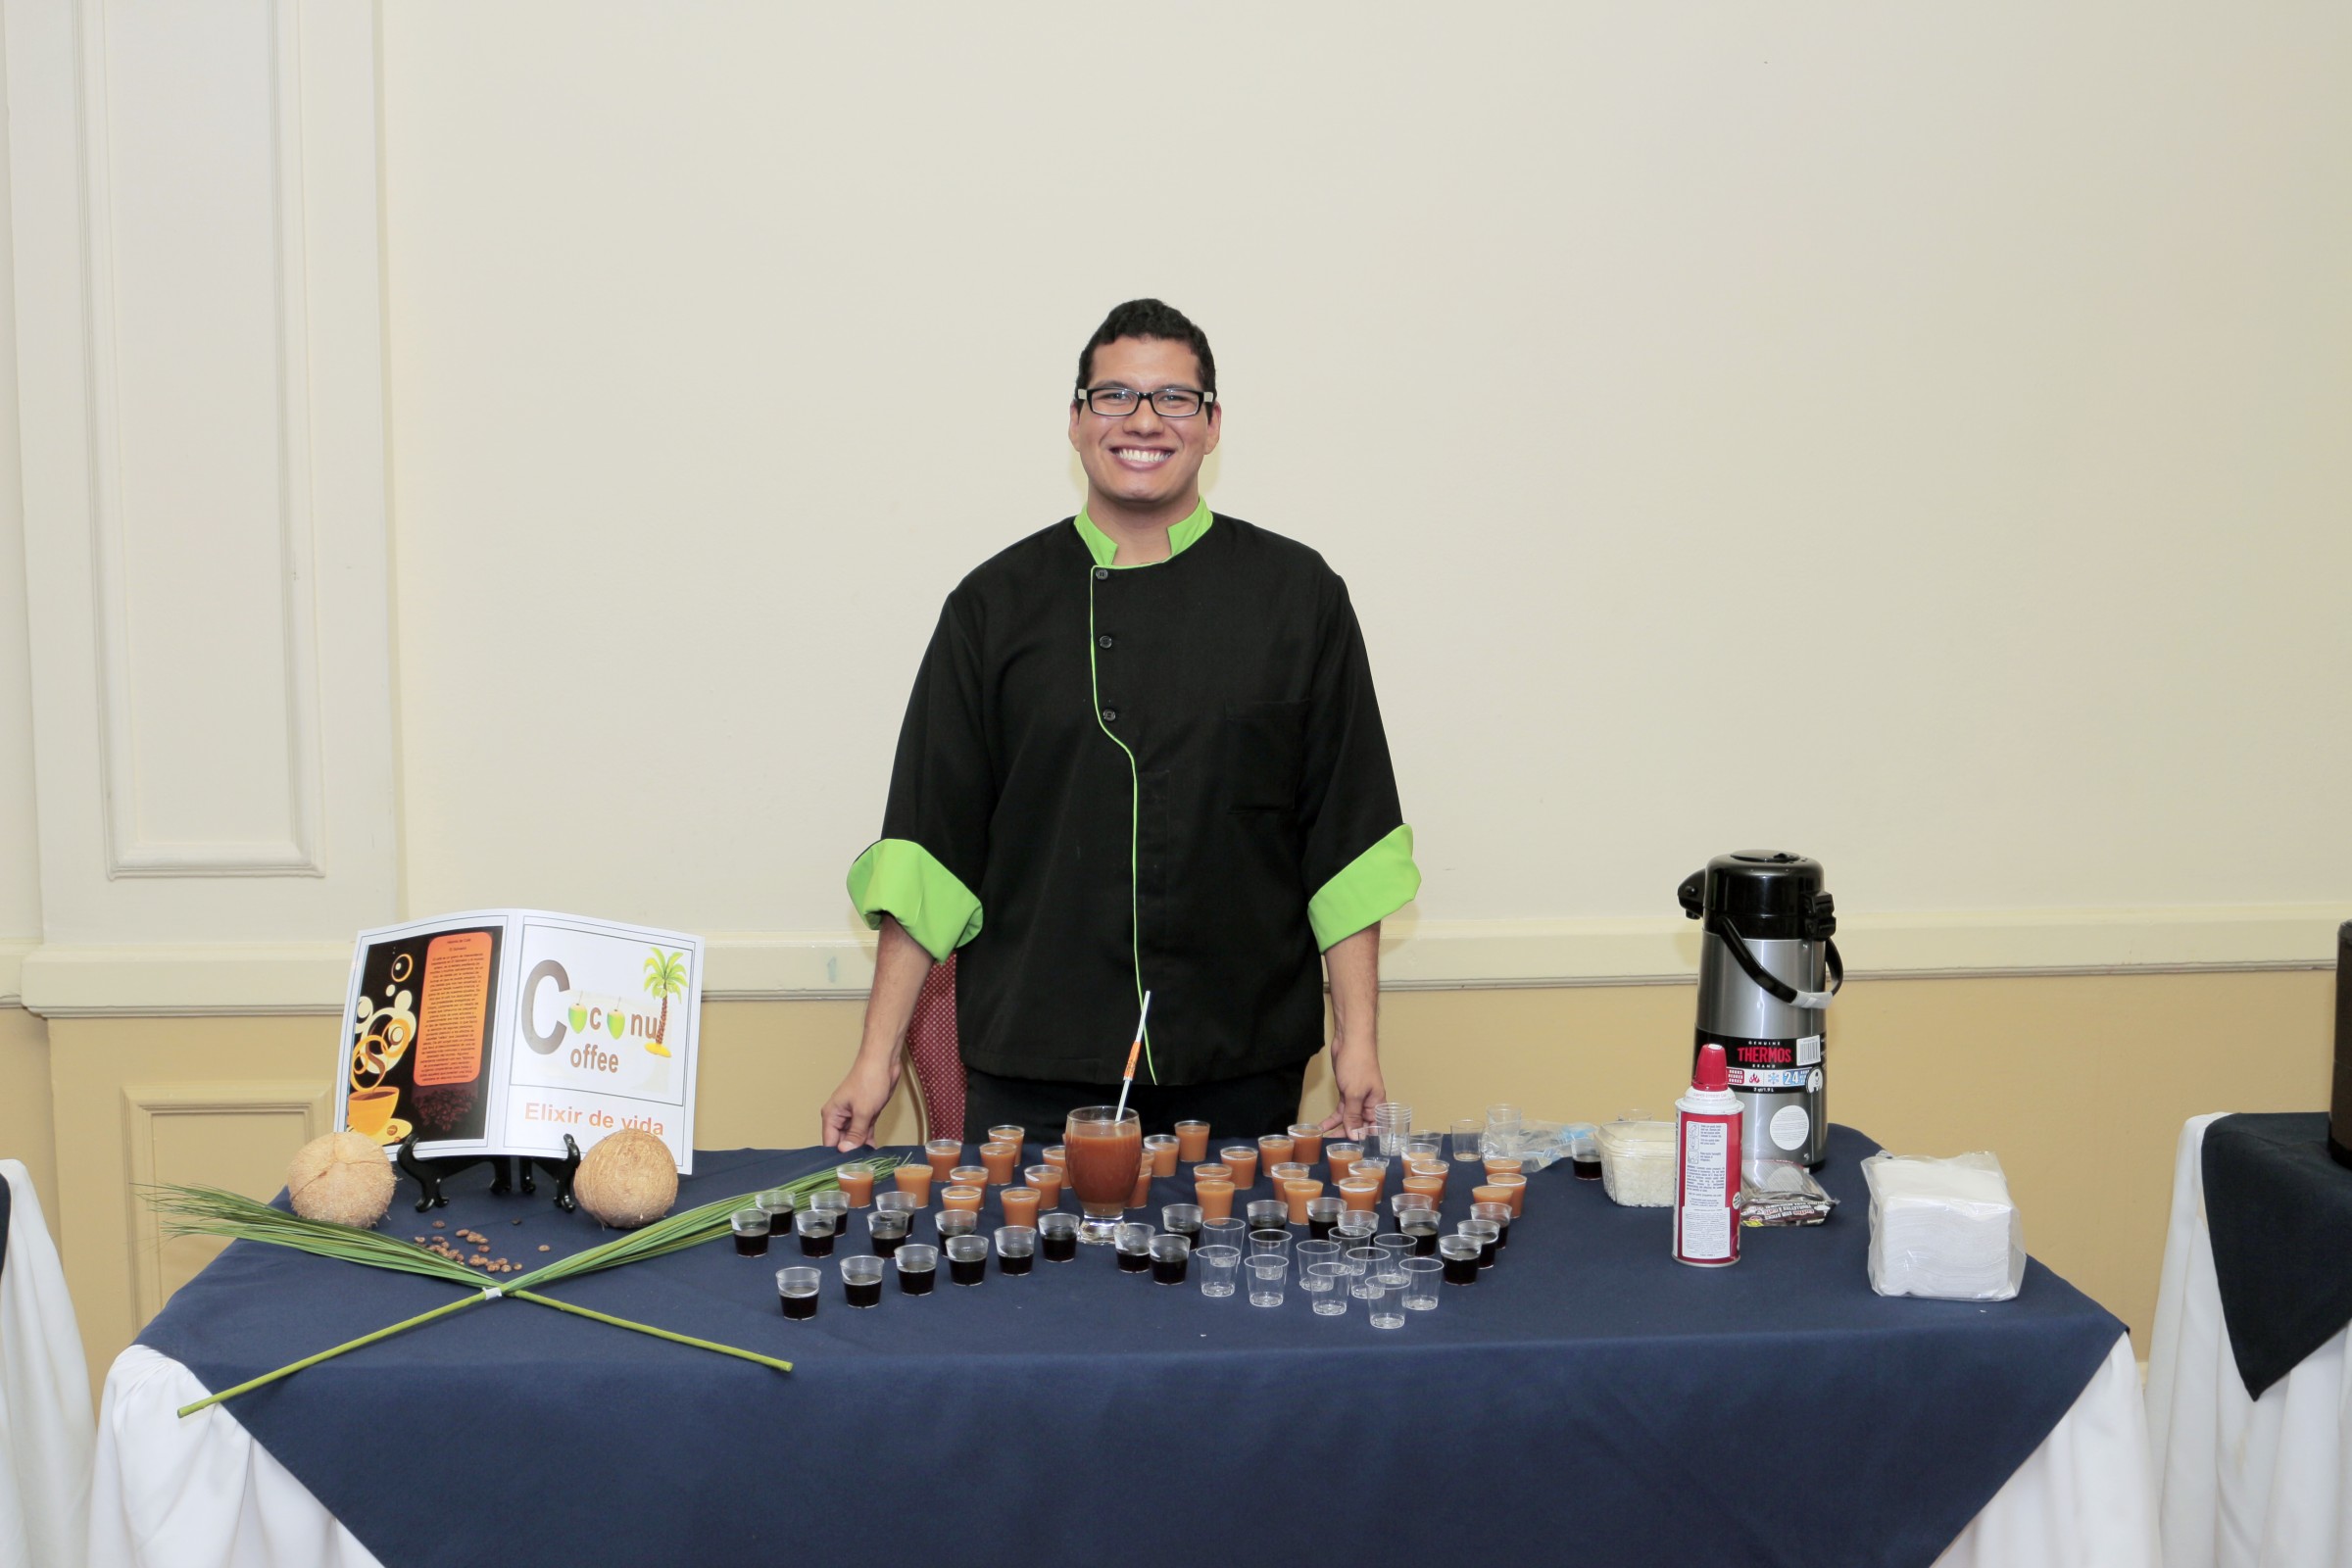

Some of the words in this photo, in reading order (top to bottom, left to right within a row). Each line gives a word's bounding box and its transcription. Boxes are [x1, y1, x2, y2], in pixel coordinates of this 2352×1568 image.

[1738, 1047, 1792, 1063] THERMOS
[1785, 1072, 1799, 1085] 24
[524, 1102, 583, 1125] Elixir
[588, 1109, 614, 1129] de
[620, 1115, 664, 1136] vida
